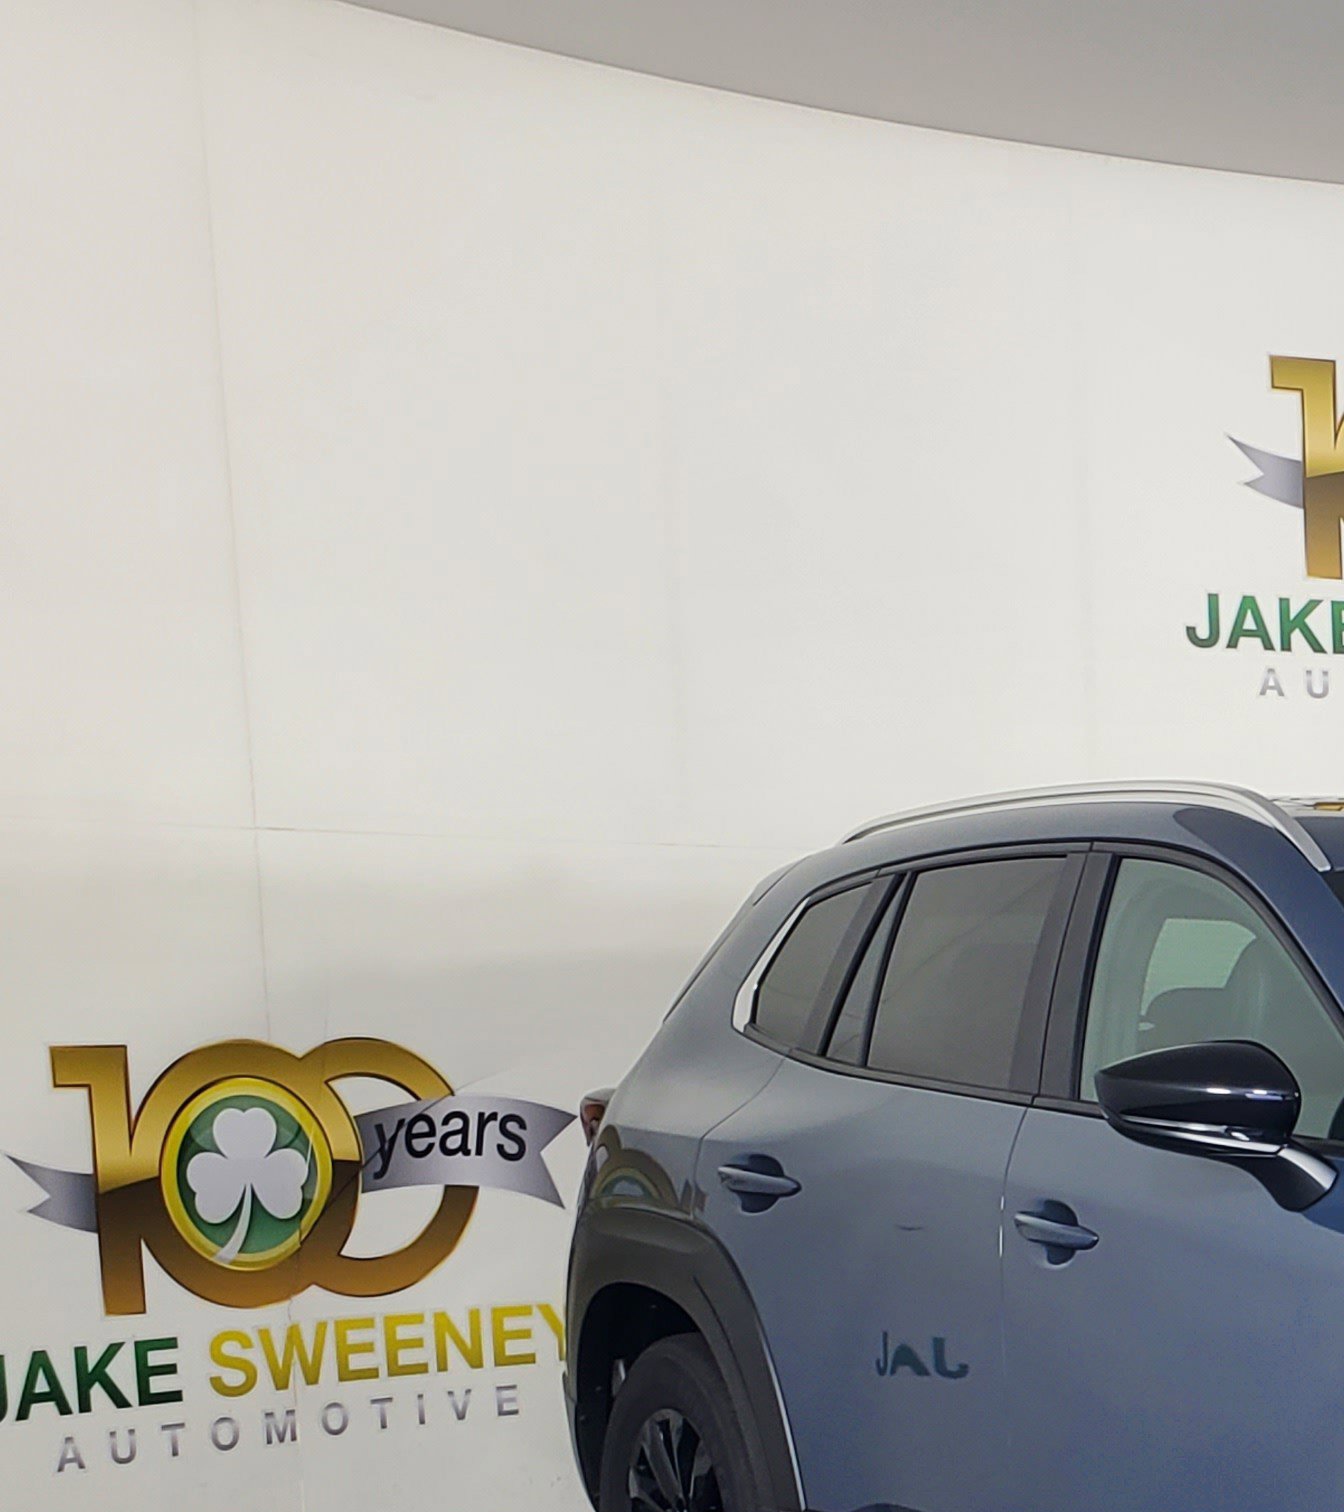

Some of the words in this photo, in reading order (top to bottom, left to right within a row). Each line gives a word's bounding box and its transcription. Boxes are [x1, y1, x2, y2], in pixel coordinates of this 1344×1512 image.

[50, 1037, 480, 1316] 100
[373, 1109, 528, 1180] years
[56, 1384, 519, 1473] AUTOMOTIVE
